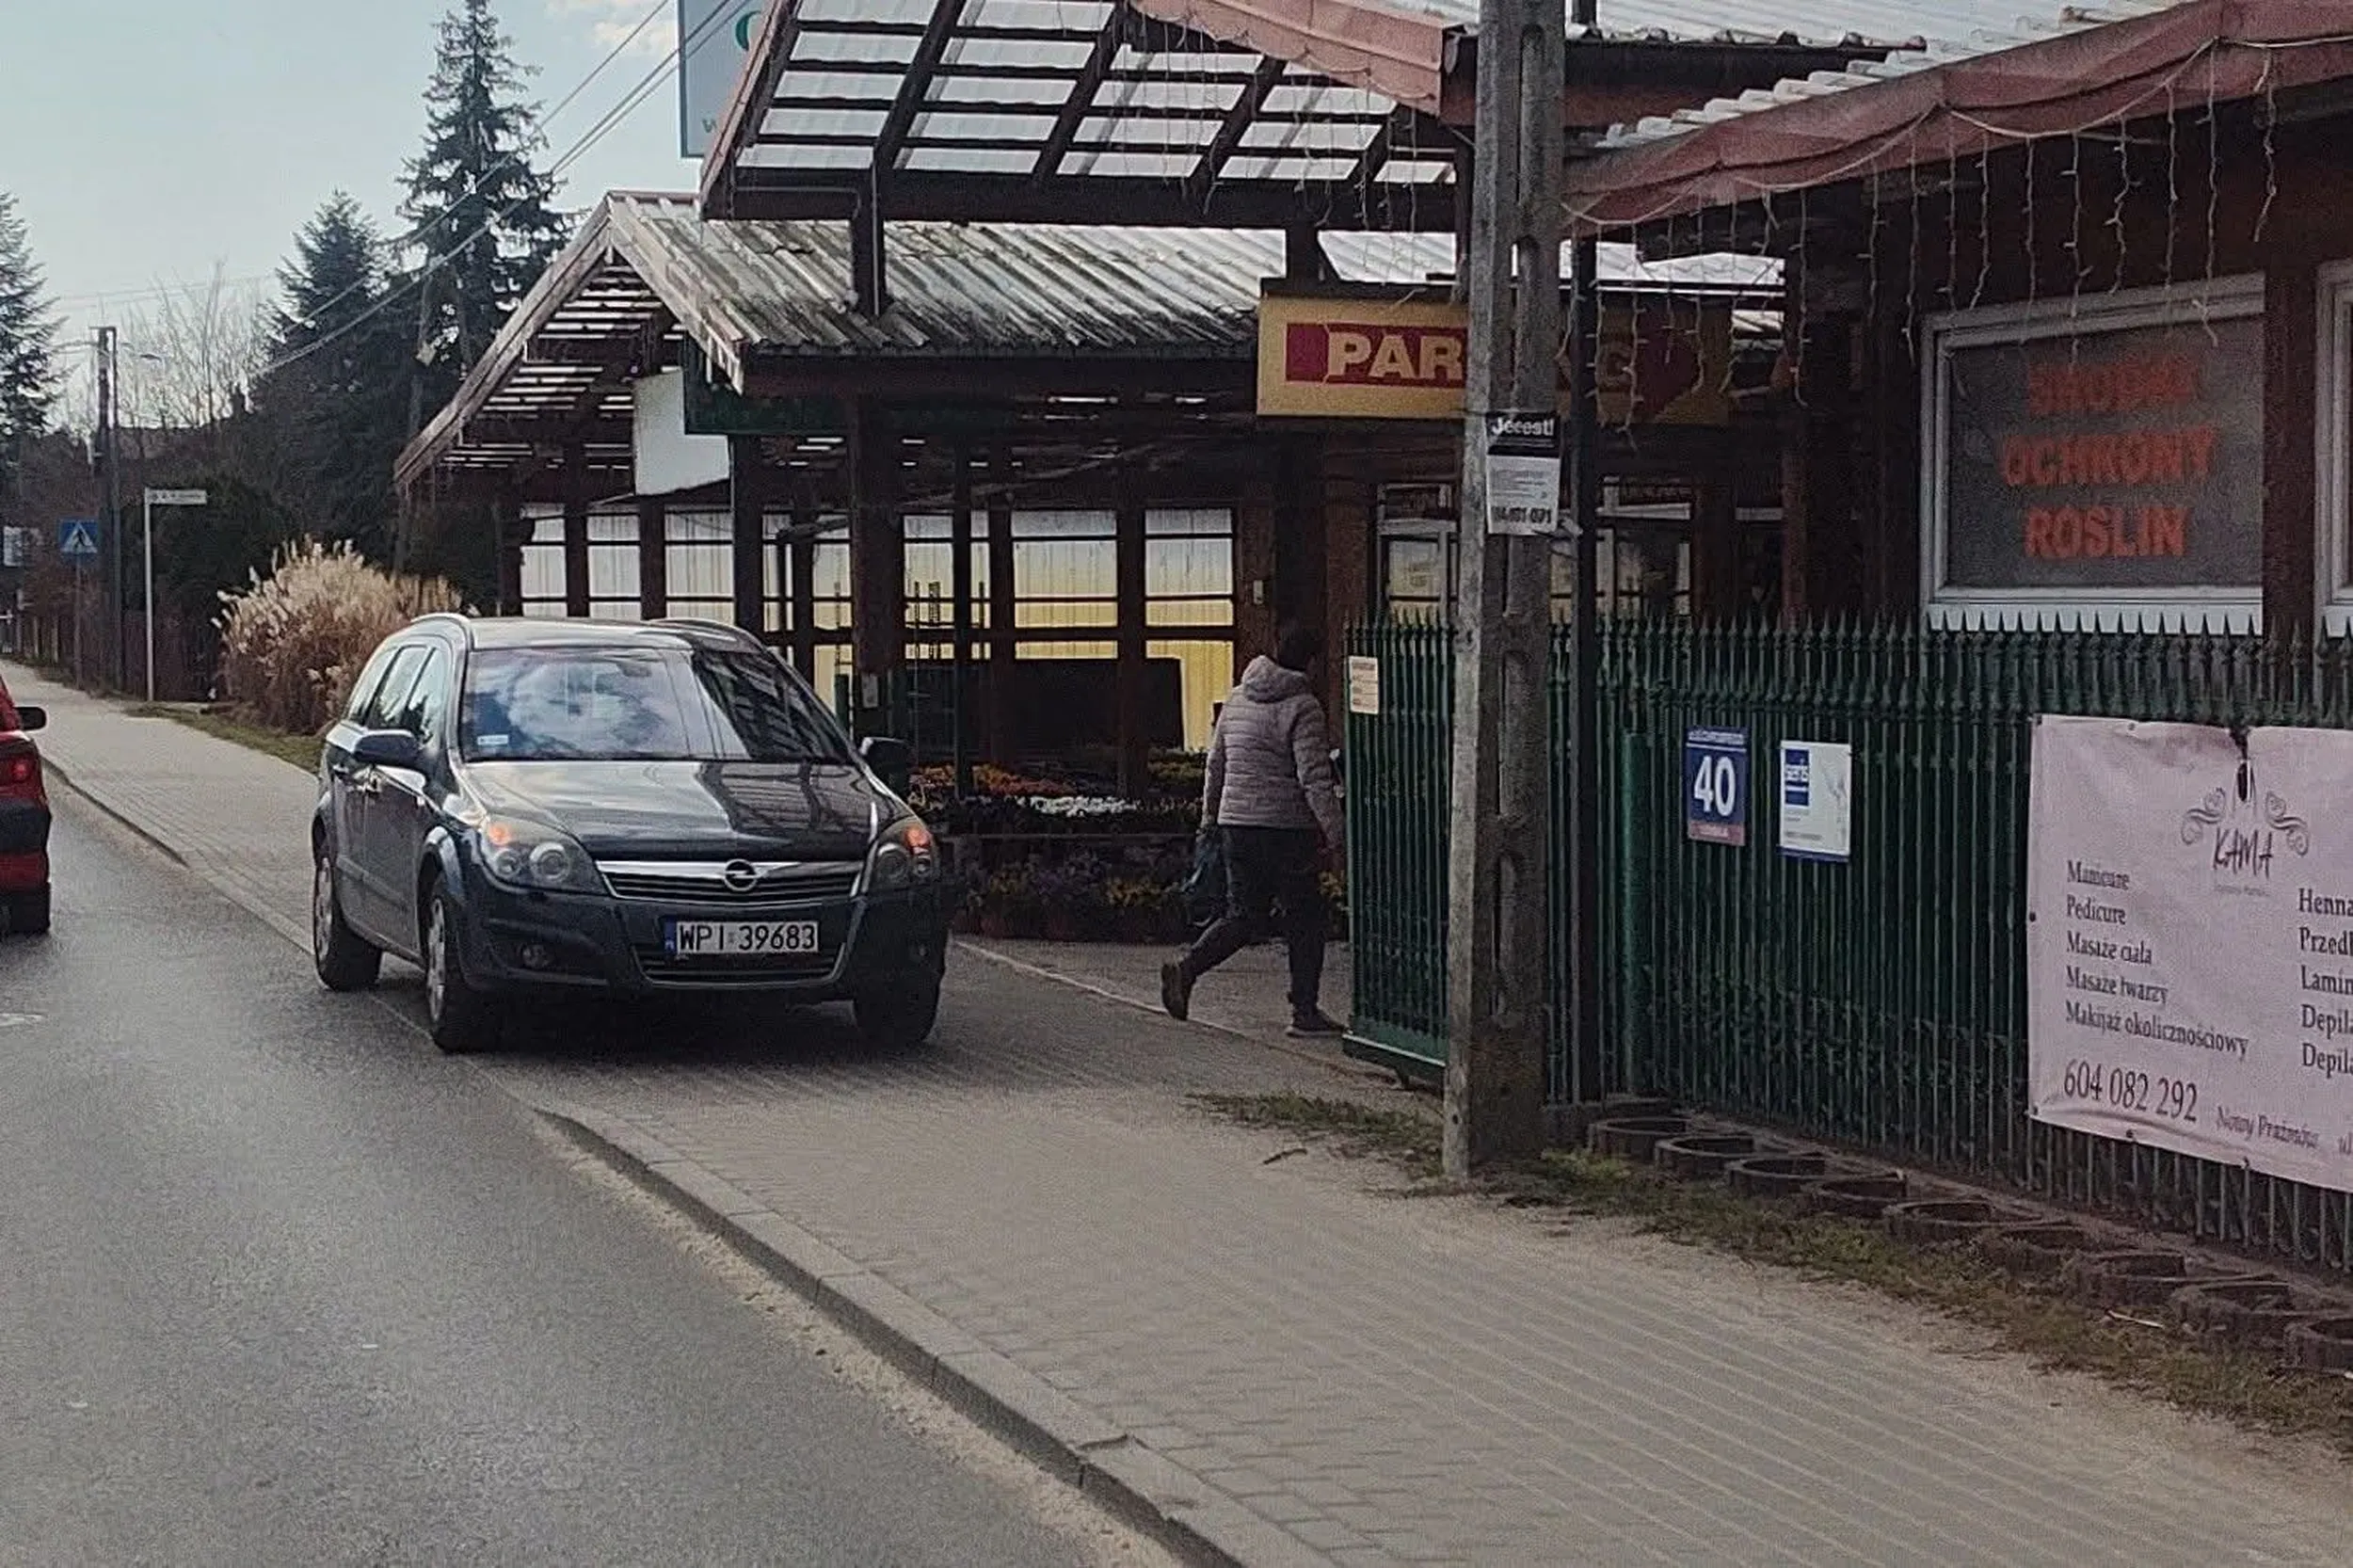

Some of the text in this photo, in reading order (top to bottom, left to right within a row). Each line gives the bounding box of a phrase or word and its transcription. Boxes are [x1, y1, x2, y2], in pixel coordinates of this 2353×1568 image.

[1694, 756, 1736, 817] 40
[2067, 859, 2130, 890] Manicure
[2067, 894, 2126, 925] Pedicure
[680, 924, 815, 951] WPI 39683
[2064, 1059, 2198, 1122] 604 082 292
